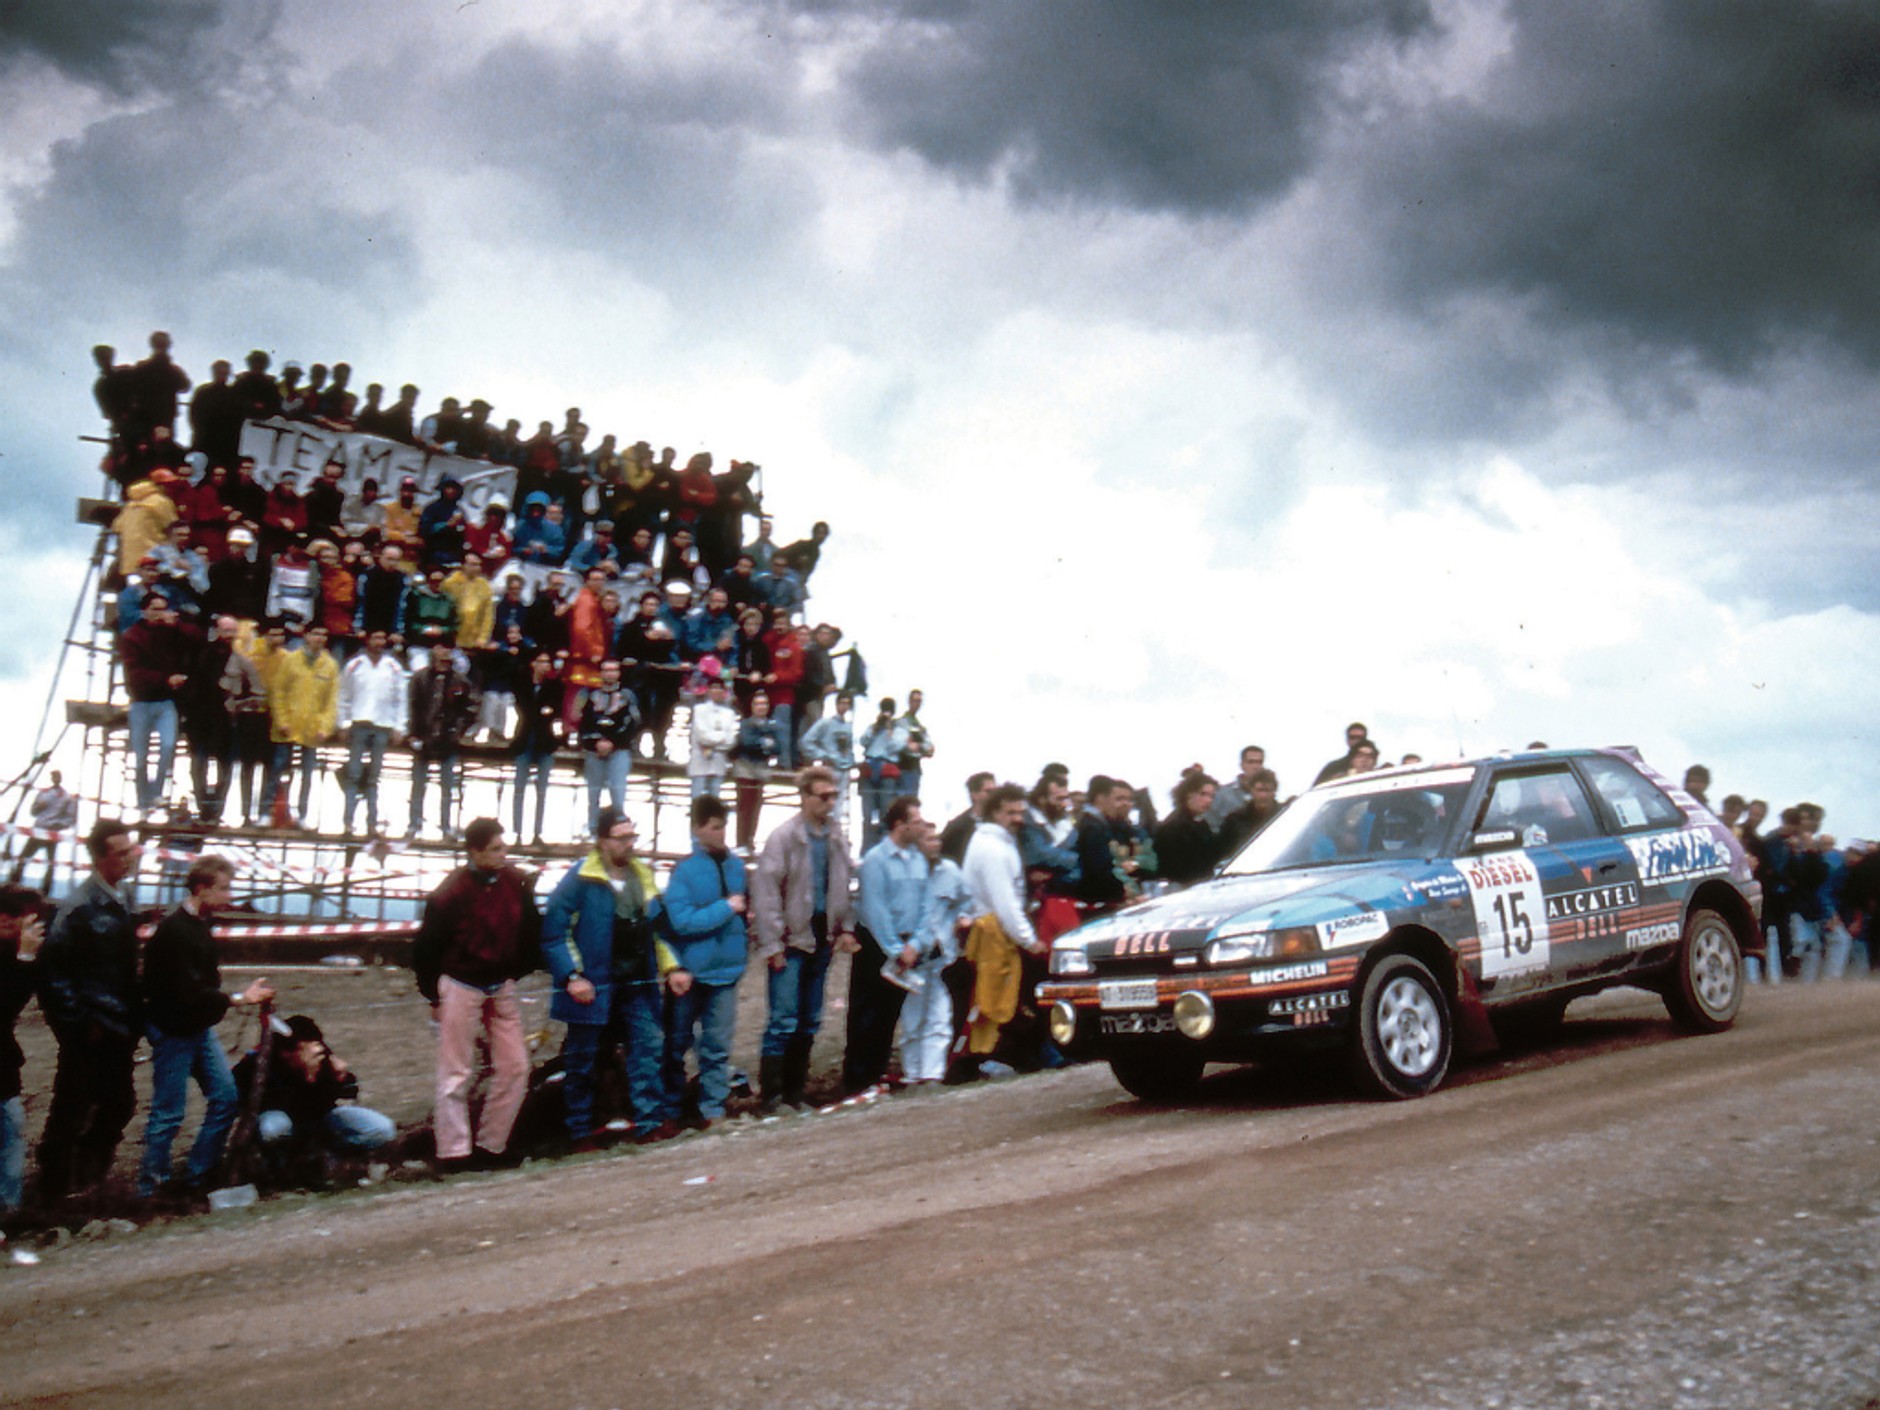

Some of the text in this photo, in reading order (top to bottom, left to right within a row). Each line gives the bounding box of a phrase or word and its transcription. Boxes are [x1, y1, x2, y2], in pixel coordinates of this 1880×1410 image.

[252, 421, 392, 486] TEAM
[1469, 864, 1533, 889] DIESEL
[1548, 884, 1637, 918] ALCATEL
[1493, 891, 1532, 958] 15
[1250, 961, 1327, 984] MICHELIN
[1271, 994, 1348, 1012] ALCATEL
